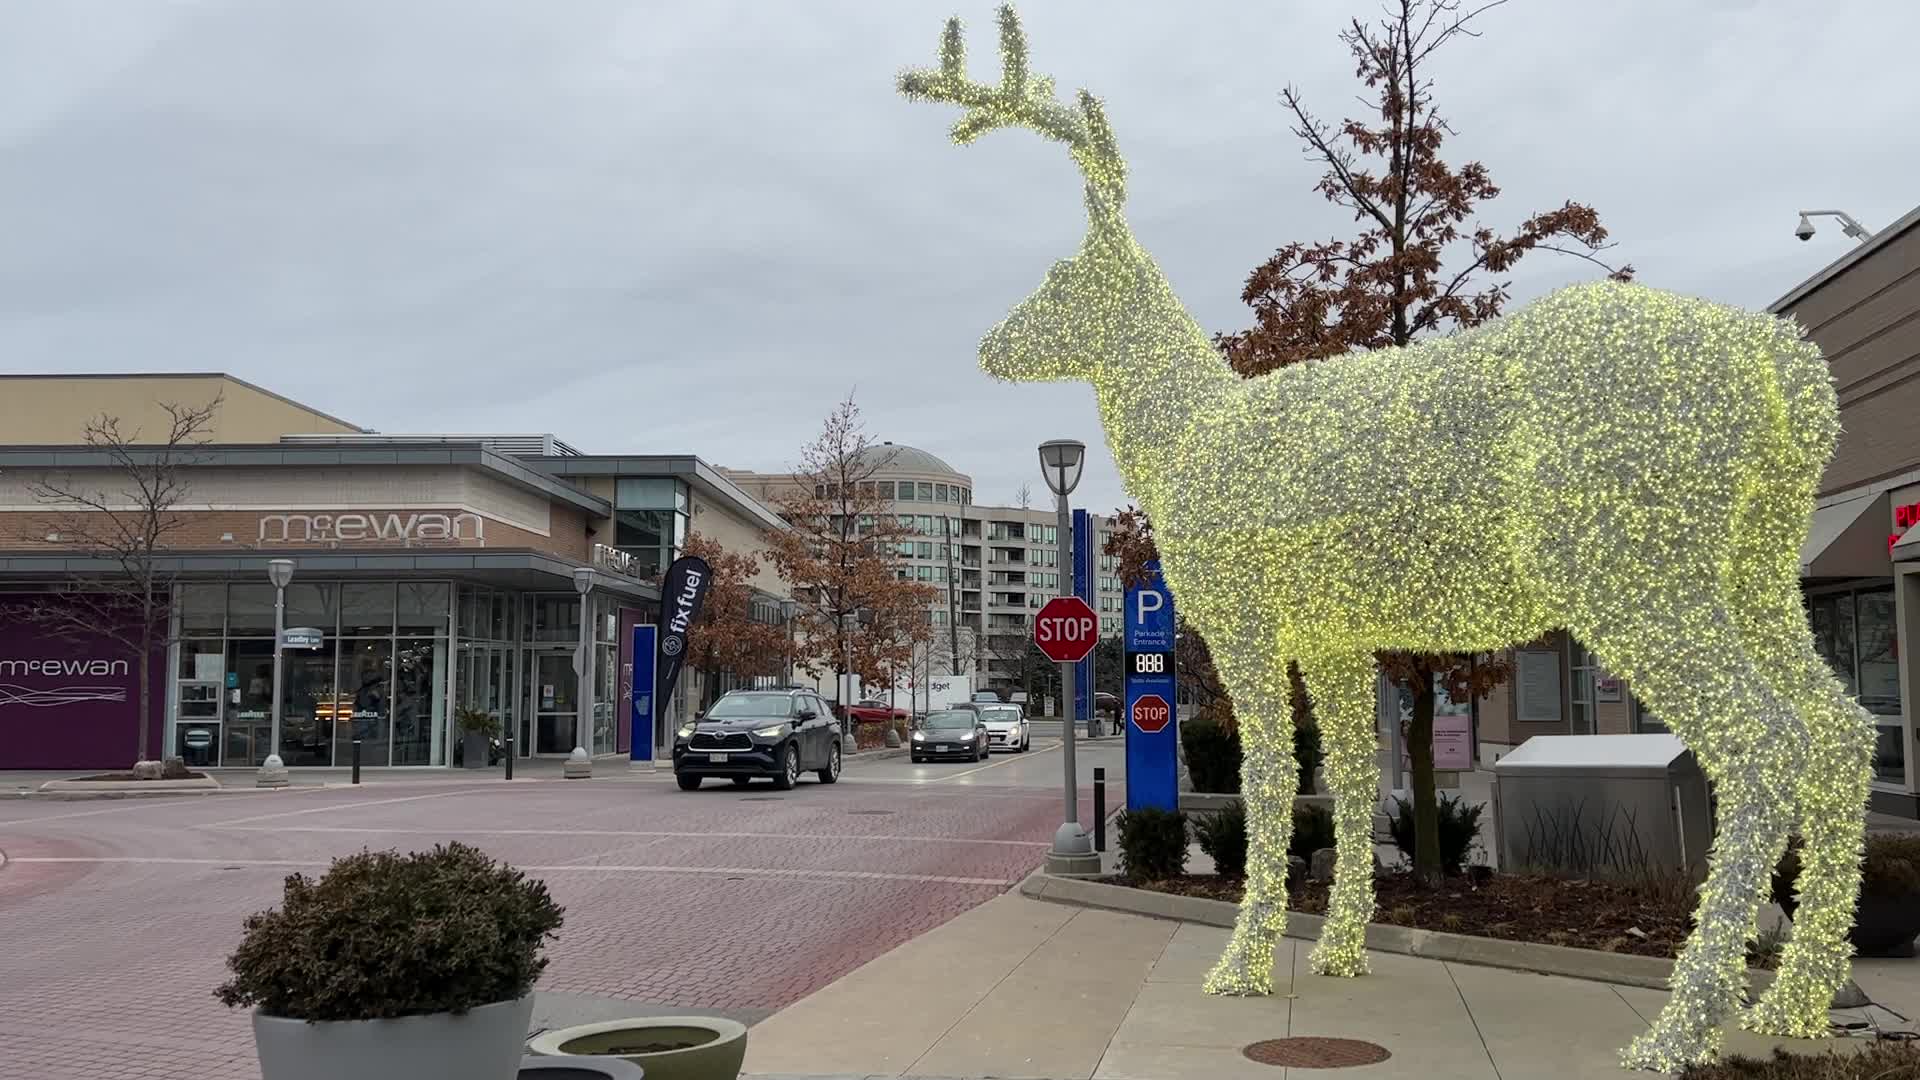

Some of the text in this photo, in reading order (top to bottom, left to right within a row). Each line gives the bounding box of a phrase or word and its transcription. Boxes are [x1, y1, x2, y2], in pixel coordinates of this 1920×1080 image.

[670, 569, 702, 633] fix fuel
[1138, 590, 1163, 625] P
[1039, 617, 1093, 641] STOP
[0, 660, 128, 676] mcewan
[1136, 653, 1164, 673] 888
[1134, 707, 1168, 720] STOP
